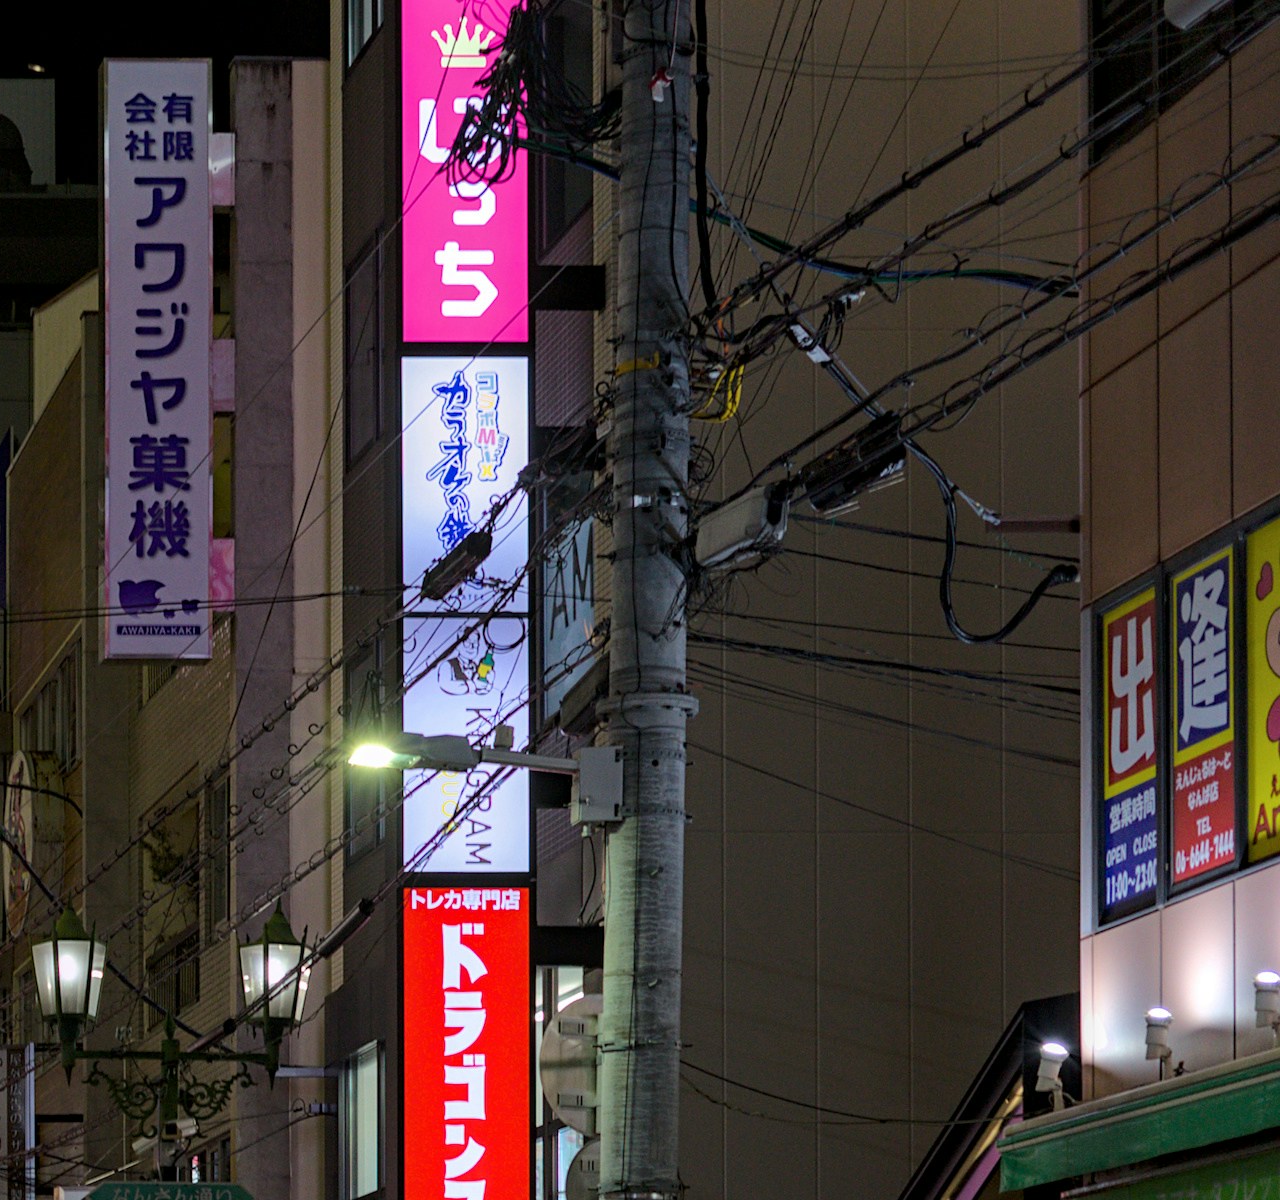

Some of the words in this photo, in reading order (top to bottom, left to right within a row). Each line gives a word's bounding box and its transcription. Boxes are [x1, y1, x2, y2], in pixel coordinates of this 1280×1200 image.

[124, 93, 157, 162] 会社
[162, 93, 194, 162] 有限
[127, 176, 191, 559] アワジヤ菓機
[1108, 786, 1157, 835] 営業時間
[1196, 815, 1213, 837] TEL
[1105, 842, 1128, 869] OPEN
[1132, 829, 1158, 857] CLOSE
[409, 889, 521, 911] トレカ専門店
